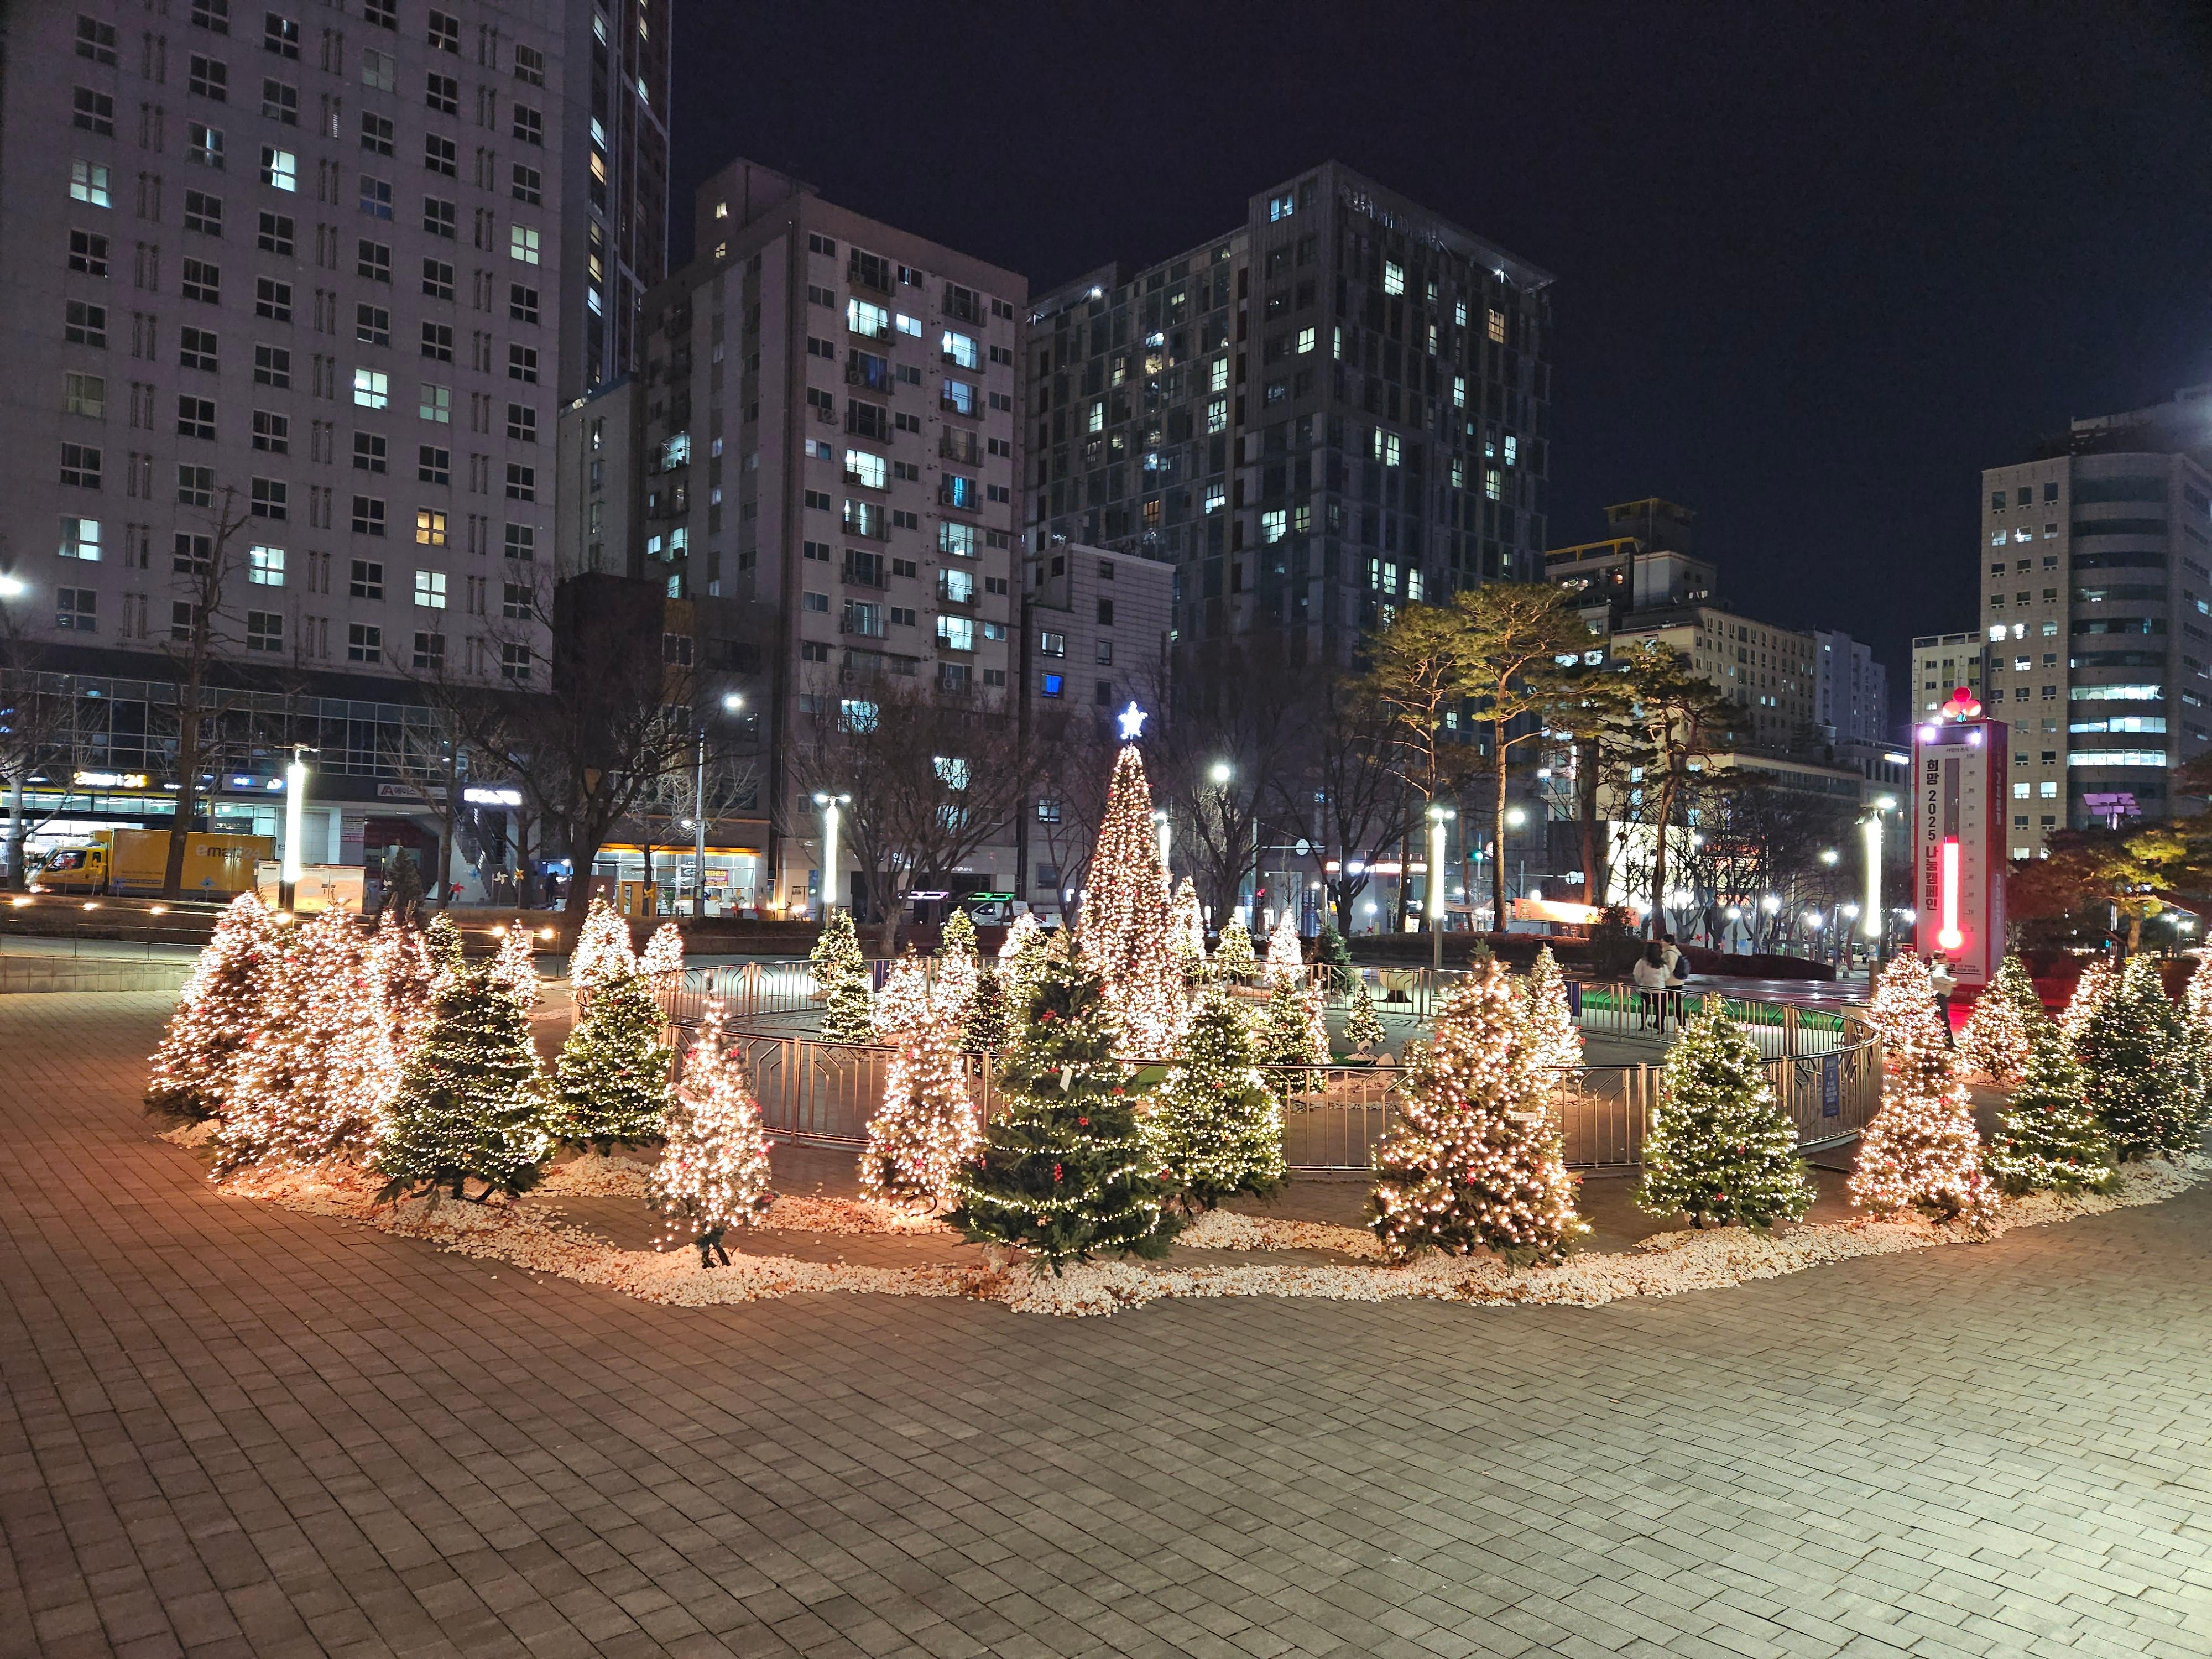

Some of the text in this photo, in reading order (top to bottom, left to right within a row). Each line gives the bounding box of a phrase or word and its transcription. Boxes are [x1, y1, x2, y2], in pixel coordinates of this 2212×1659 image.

[73, 771, 148, 787] et24
[1926, 759, 1939, 911] 희망 2025 나눔캠페인
